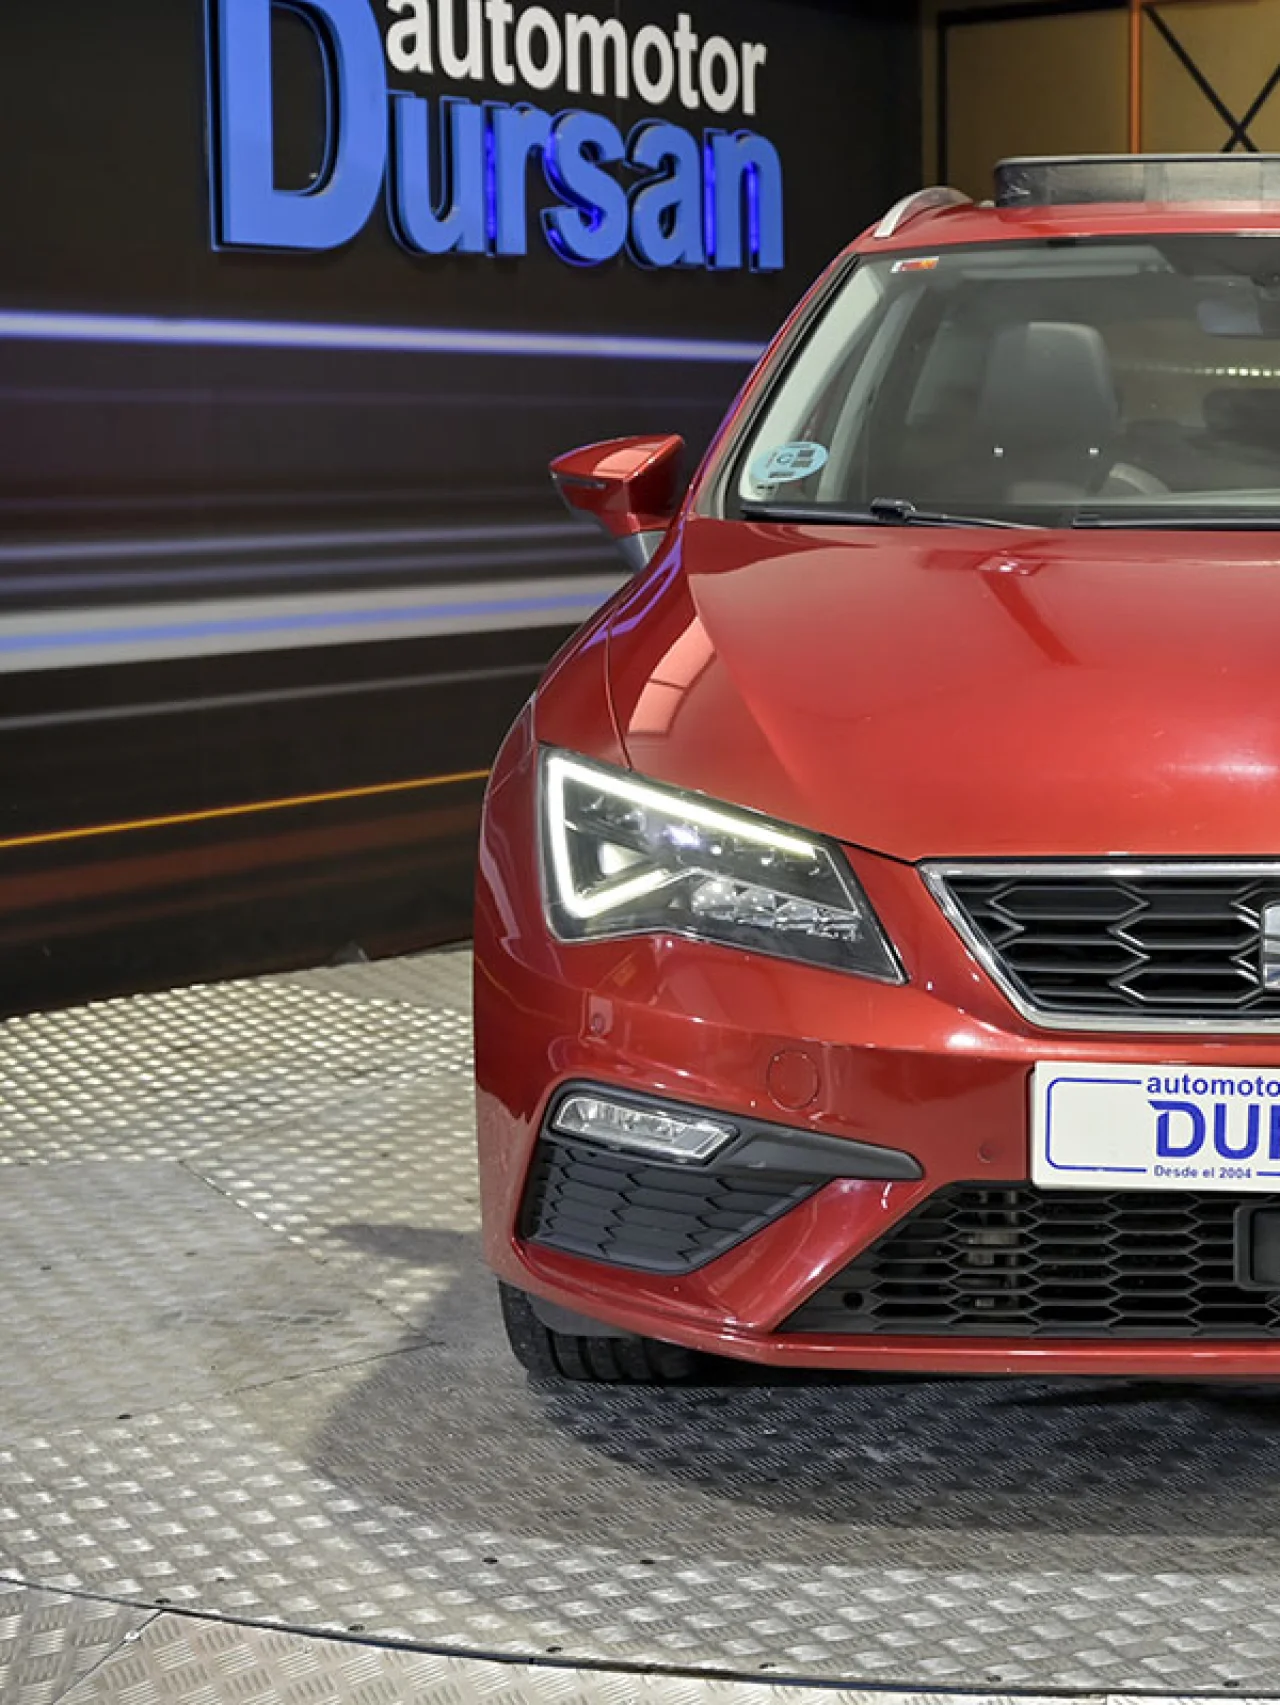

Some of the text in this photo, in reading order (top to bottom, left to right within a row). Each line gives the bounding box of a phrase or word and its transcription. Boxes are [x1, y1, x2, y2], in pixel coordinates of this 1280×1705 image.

[386, 0, 767, 116] automotor
[210, 0, 784, 271] Dursan
[1153, 1164, 1253, 1179] Desde el 2004
